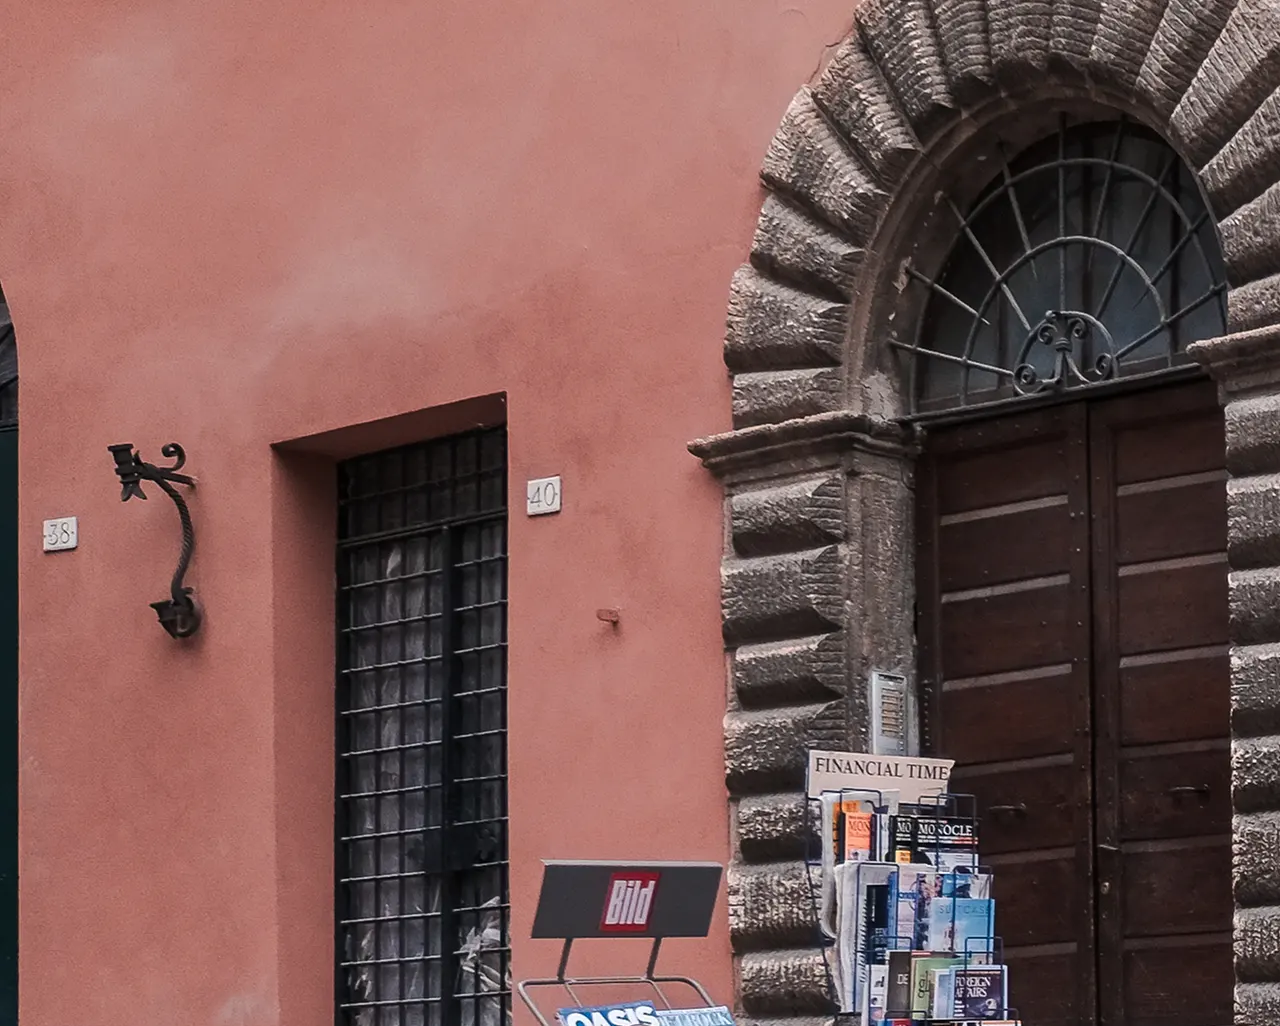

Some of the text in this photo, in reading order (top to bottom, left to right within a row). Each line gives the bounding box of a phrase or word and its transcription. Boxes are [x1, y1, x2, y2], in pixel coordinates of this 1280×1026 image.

[530, 482, 556, 507] 40
[47, 521, 70, 545] 38
[815, 757, 903, 779] FINANCIAL
[918, 822, 972, 837] MONOCLE
[604, 879, 655, 927] Bild
[955, 976, 991, 988] FOREIGN
[955, 987, 987, 998] AFAIRS
